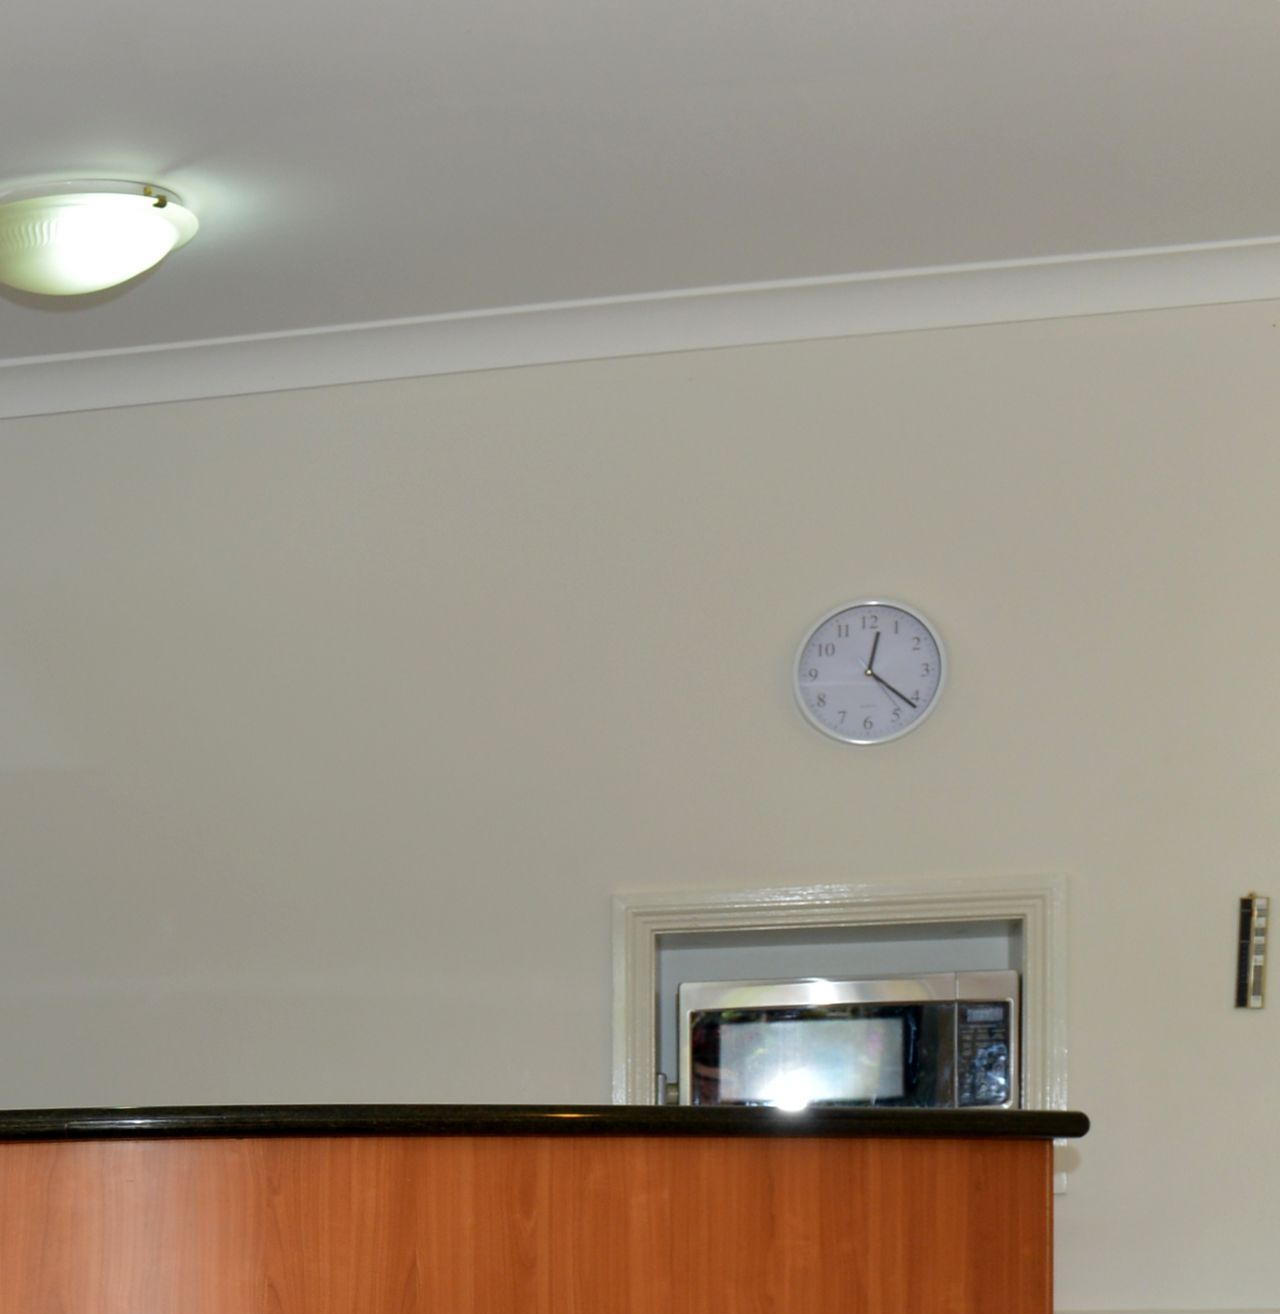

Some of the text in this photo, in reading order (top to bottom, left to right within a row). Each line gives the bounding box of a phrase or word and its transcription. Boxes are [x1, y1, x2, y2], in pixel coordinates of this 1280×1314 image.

[861, 615, 879, 630] 12
[893, 620, 899, 635] 1
[837, 624, 849, 638] 11
[817, 643, 835, 657] 10
[912, 637, 921, 651] 2
[808, 668, 818, 682] 9
[920, 662, 930, 677] 3
[816, 693, 826, 707] 8
[837, 710, 847, 724] 7
[891, 707, 901, 722] 5
[863, 715, 873, 730] 6
